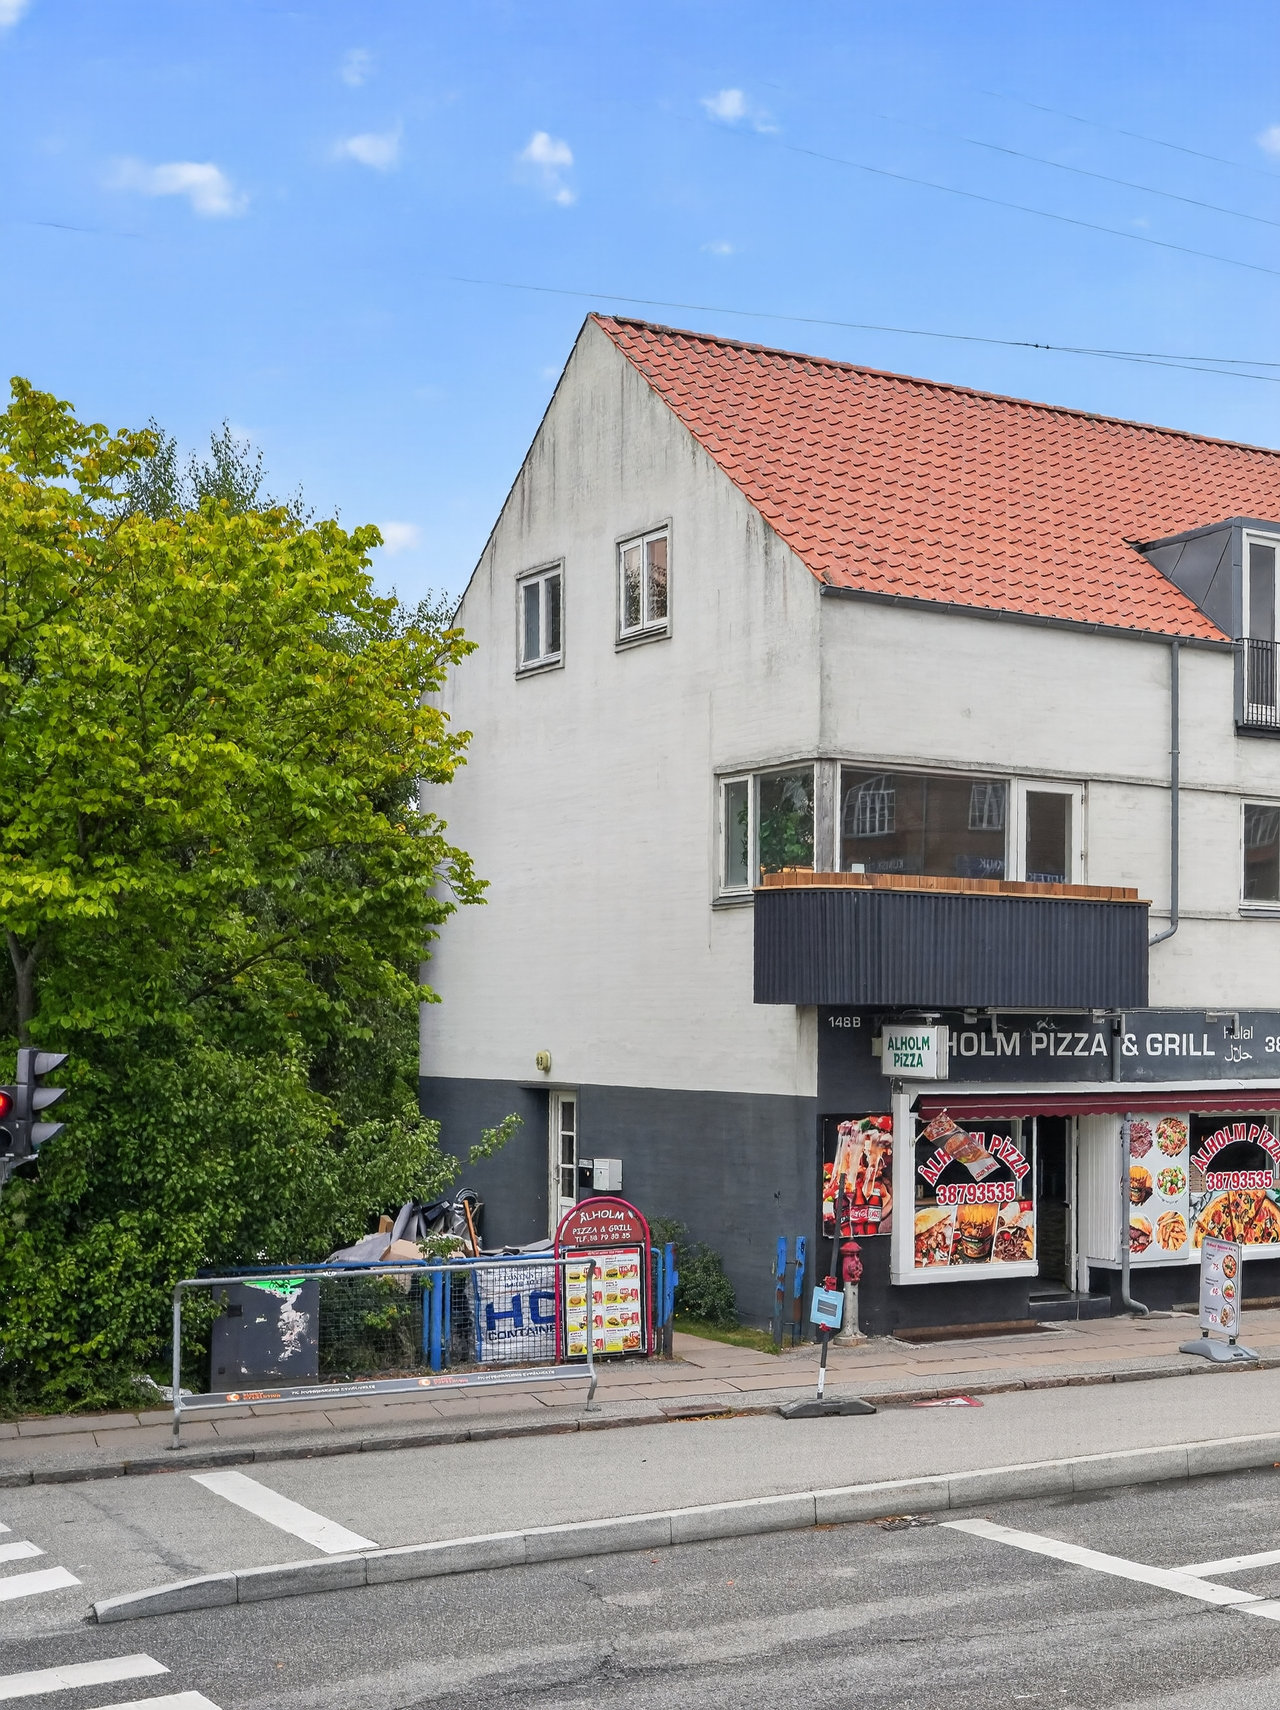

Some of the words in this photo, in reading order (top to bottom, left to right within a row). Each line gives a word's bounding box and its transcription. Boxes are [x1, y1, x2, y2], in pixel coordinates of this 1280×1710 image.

[1031, 1033, 1109, 1057] PIZZA
[1121, 1033, 1139, 1057] &
[1146, 1033, 1215, 1057] GRILL
[1190, 1122, 1248, 1174] ÅLHOLM
[1205, 1170, 1275, 1192] 38793535
[936, 1182, 1016, 1205] 38793535
[580, 1209, 625, 1224] ÅLHOLM
[572, 1226, 598, 1235] PIZZA
[608, 1223, 632, 1233] GRILL
[488, 1324, 562, 1341] CONTAINE
